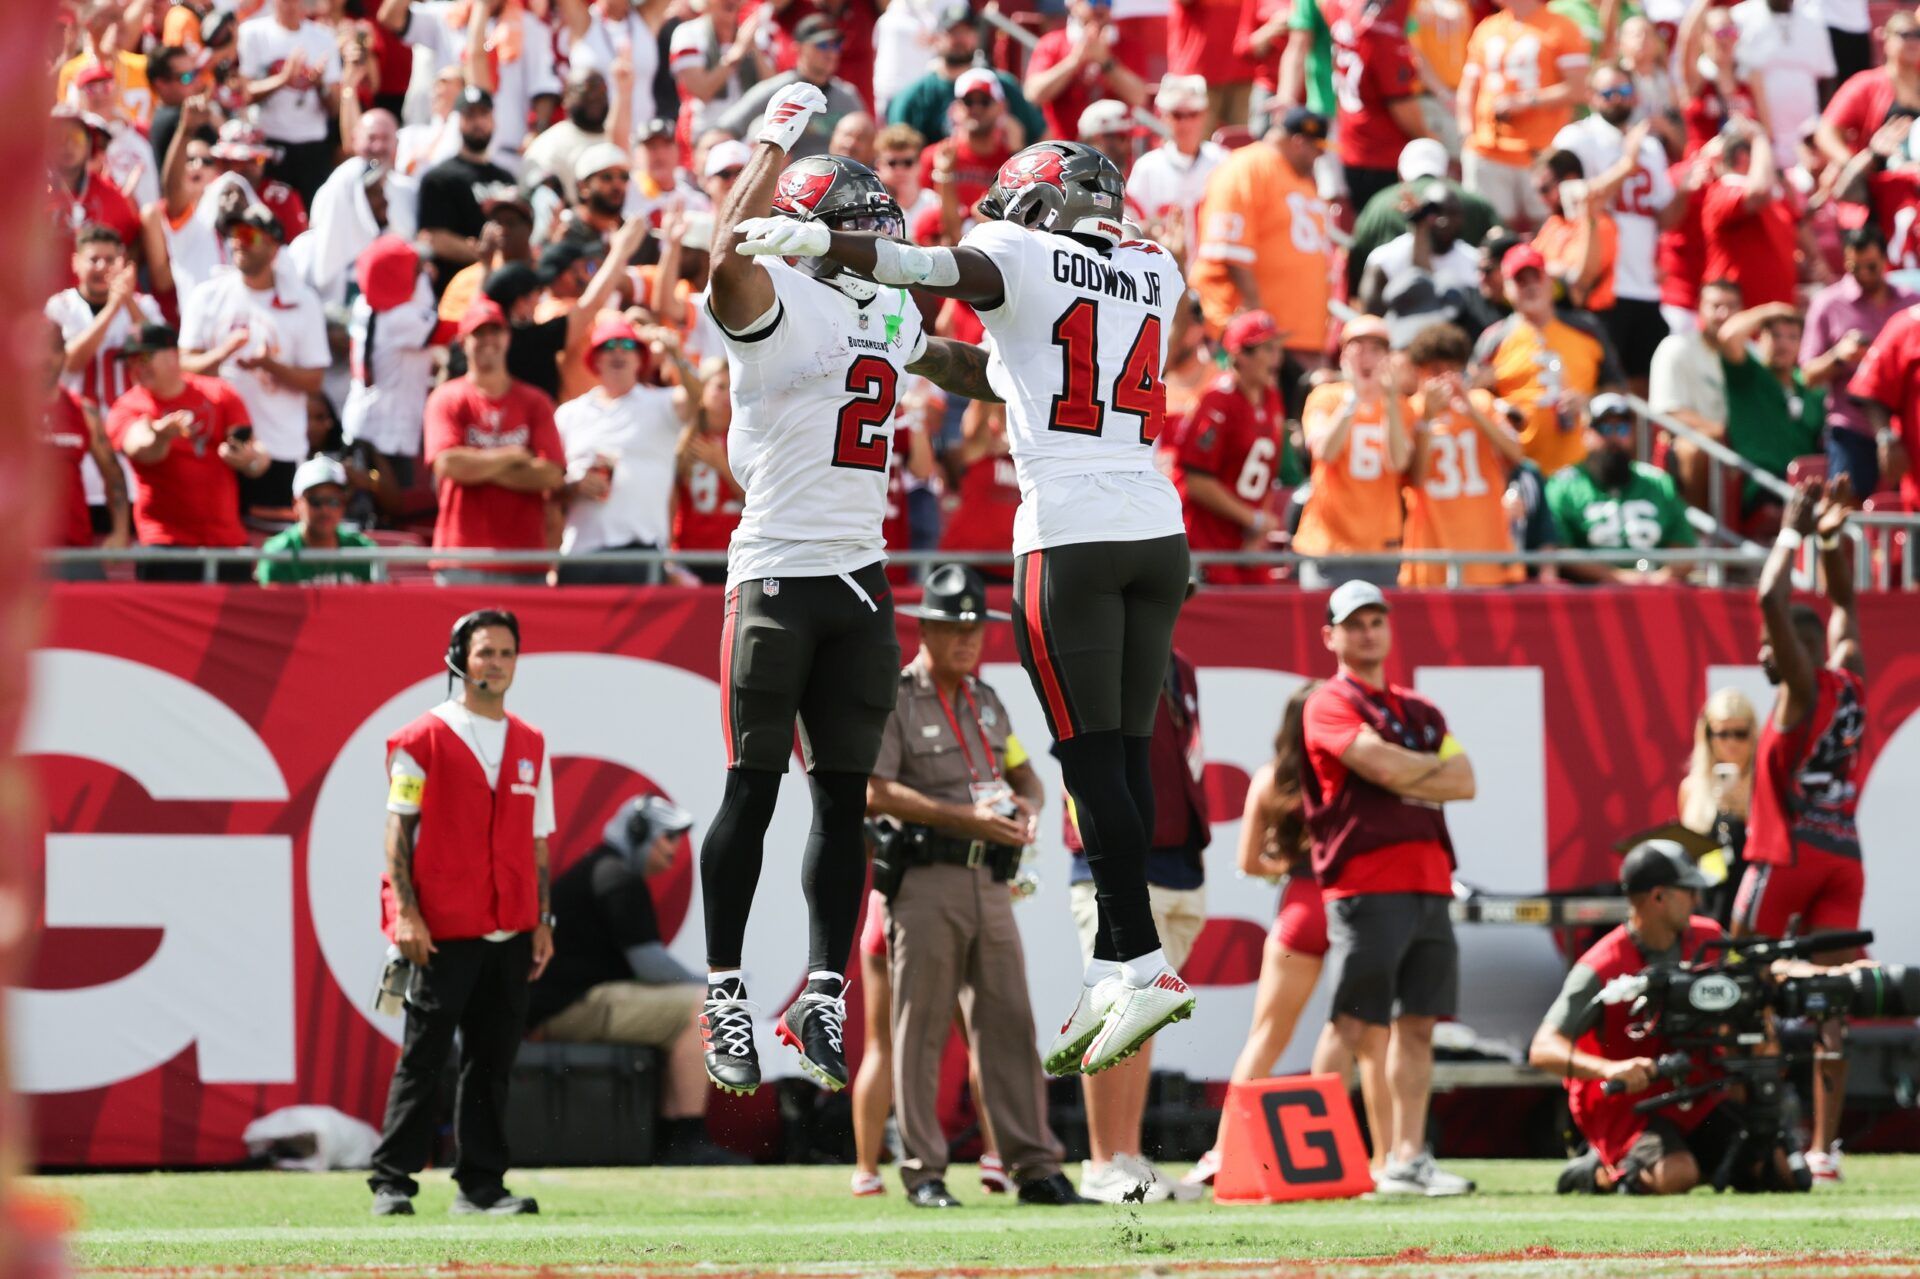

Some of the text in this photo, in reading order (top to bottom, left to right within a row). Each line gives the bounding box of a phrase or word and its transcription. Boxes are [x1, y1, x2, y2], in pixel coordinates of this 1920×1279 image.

[1053, 249, 1162, 308] GODWIN JR
[1048, 297, 1167, 446] 14
[831, 354, 899, 473] 2
[1236, 436, 1277, 500] 6
[1424, 429, 1490, 499] 31
[1583, 499, 1663, 550] 26
[1154, 973, 1188, 994] NIKE
[1261, 1089, 1344, 1185] G
